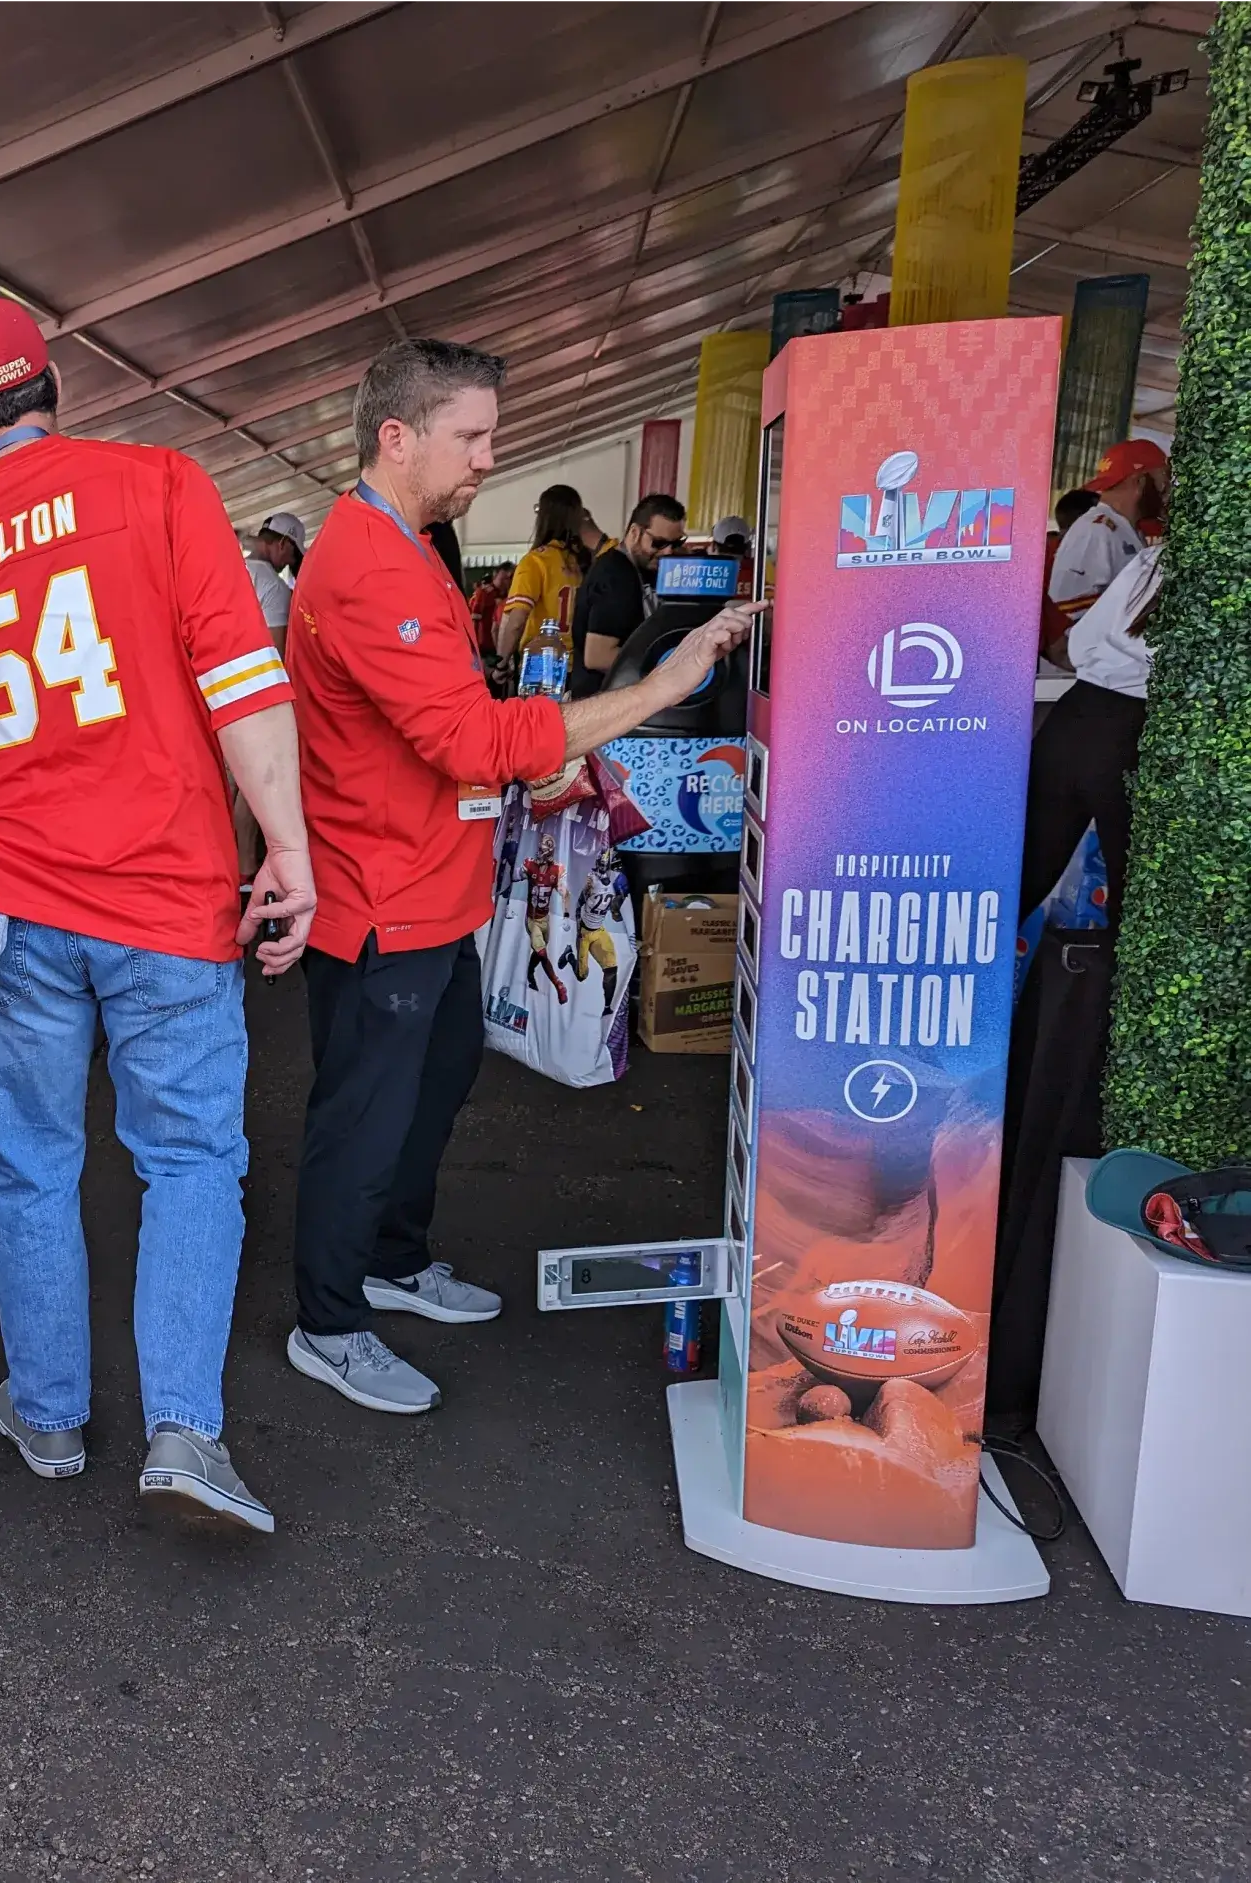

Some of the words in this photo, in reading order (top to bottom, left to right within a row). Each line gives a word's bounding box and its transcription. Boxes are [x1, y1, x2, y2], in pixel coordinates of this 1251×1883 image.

[838, 487, 1015, 554] LVII
[851, 552, 923, 564] SUPER
[935, 550, 997, 561] BOWL
[681, 577, 703, 588] CANS
[705, 577, 728, 589] ONLY
[836, 719, 868, 734] ON
[876, 716, 988, 734] LOCATION
[835, 854, 951, 878] HOSPITALITY
[780, 888, 999, 965] CHARGING
[689, 988, 728, 1002] CLASSIC
[795, 970, 975, 1046] STATION
[581, 1267, 592, 1284] 8
[785, 1322, 813, 1340] Wilson
[824, 1322, 897, 1355] LVII
[830, 1347, 858, 1356] SUPER
[863, 1352, 888, 1360] BOWL
[903, 1345, 962, 1355] COMMISSIONER
